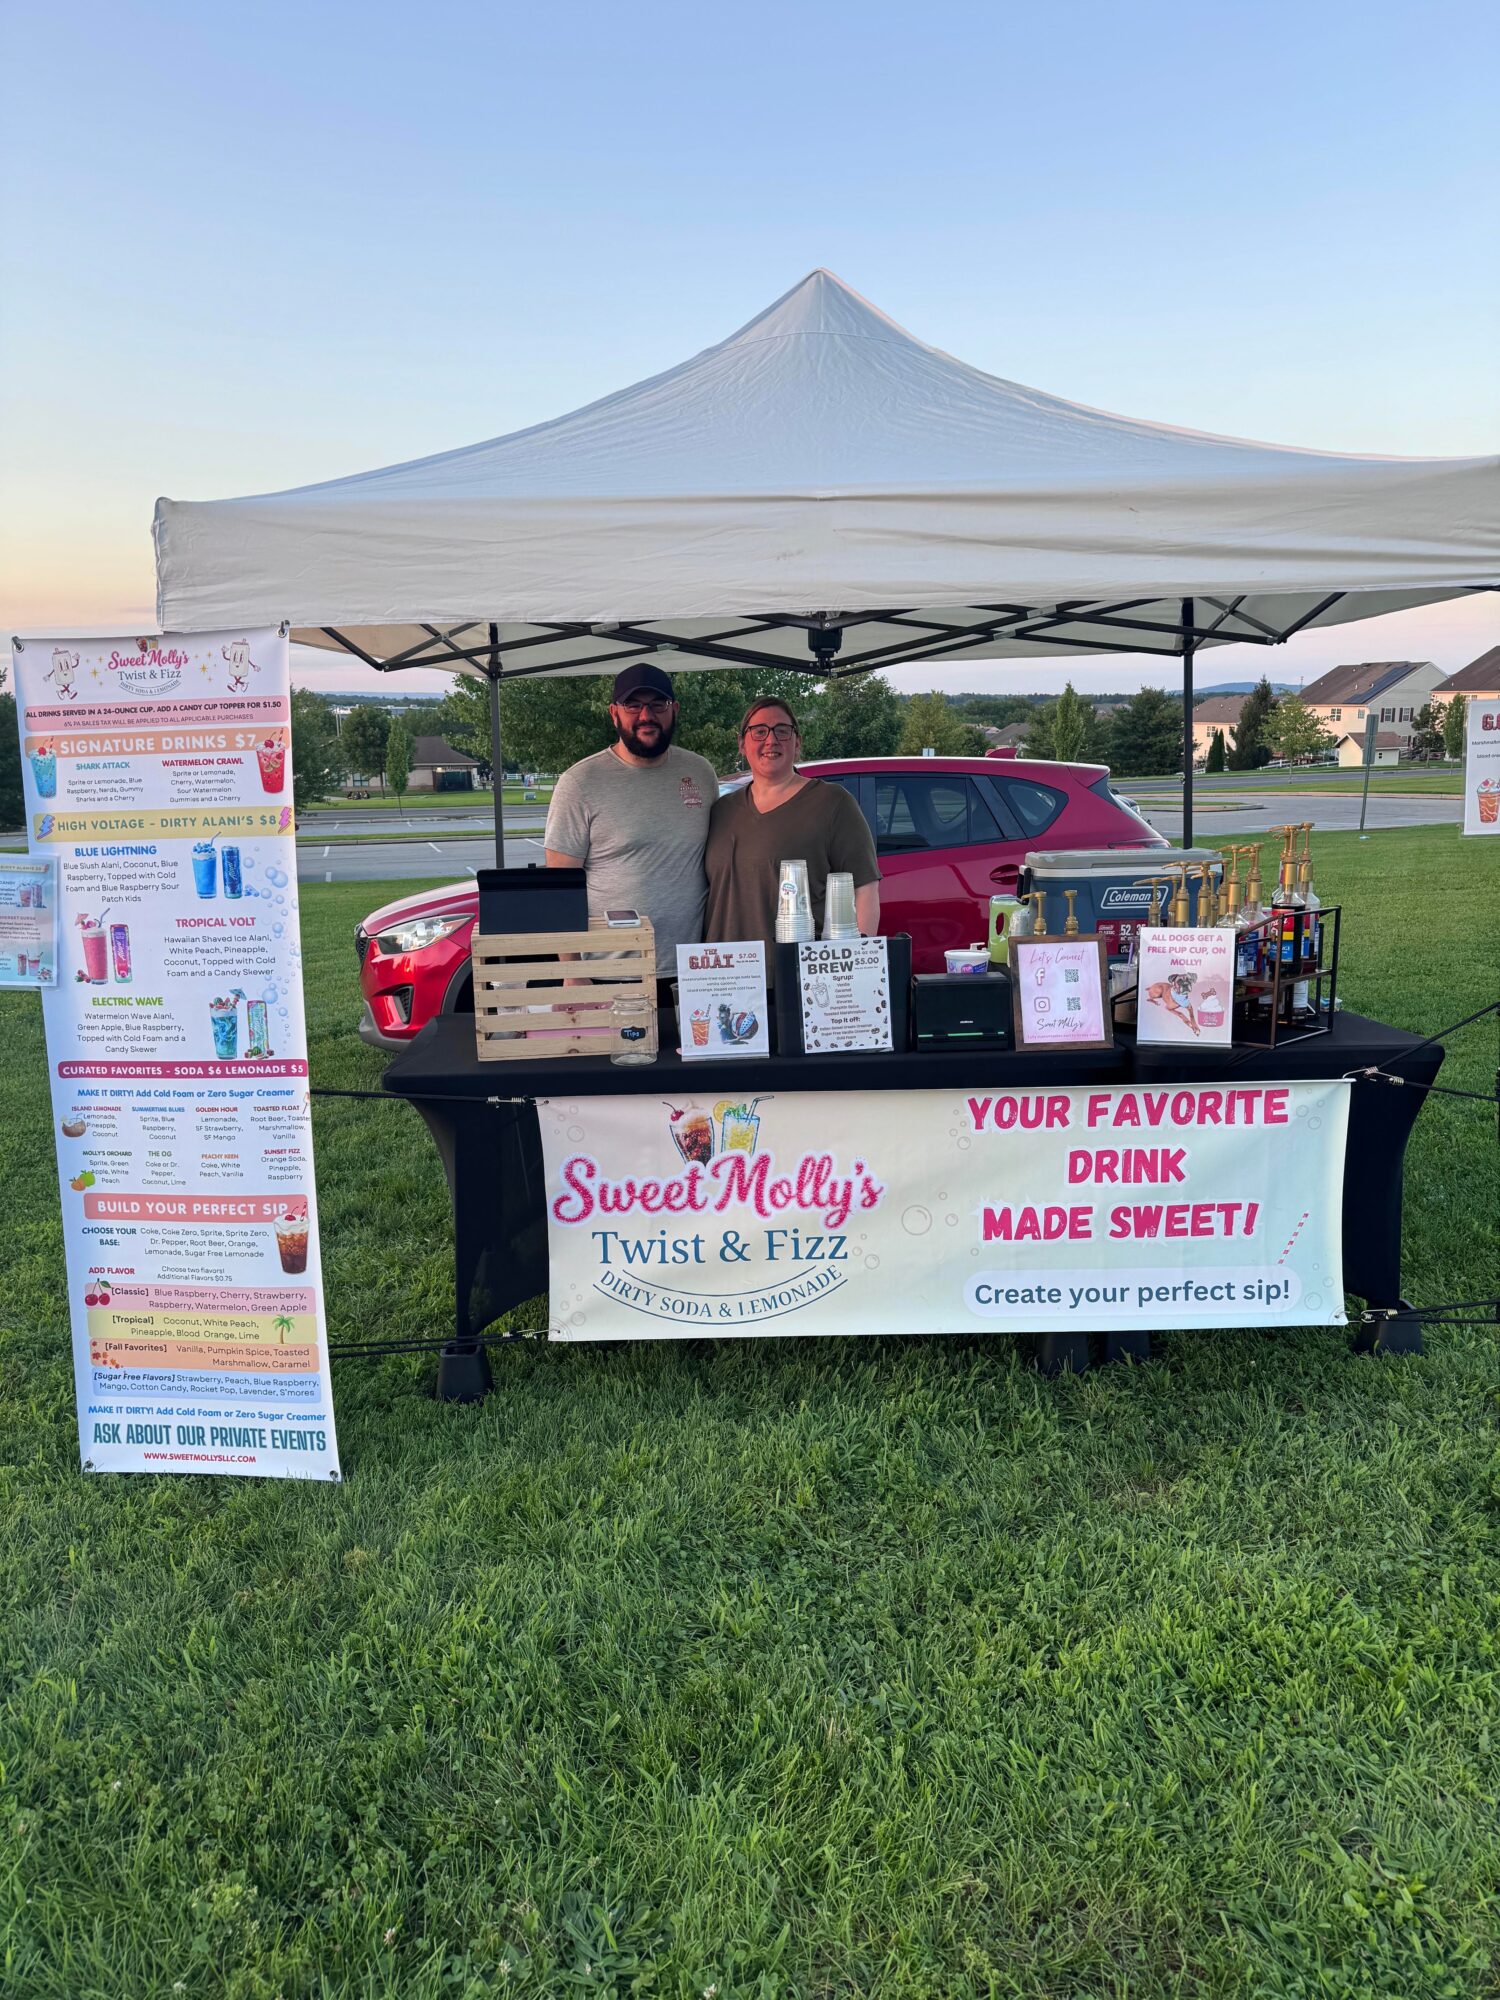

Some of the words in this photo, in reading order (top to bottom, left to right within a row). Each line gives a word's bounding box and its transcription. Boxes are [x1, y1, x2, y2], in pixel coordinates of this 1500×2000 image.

[108, 651, 149, 671] Sweet
[149, 650, 189, 670] Molly's
[117, 670, 147, 680] Twist
[149, 669, 158, 679] &
[160, 669, 182, 679] Fizz
[103, 706, 137, 714] 24-OUNCE
[262, 700, 281, 708] $1.50
[60, 737, 154, 754] SIGNATURE
[162, 734, 226, 750] DRINKS
[235, 733, 257, 748] $7
[76, 762, 100, 770] SHARK
[102, 761, 130, 769] ATTACK
[161, 758, 214, 767] WATERMELON
[216, 757, 243, 765] CRAWL
[57, 820, 86, 831] HIGH
[91, 818, 144, 830] VOLTAGE
[160, 817, 196, 827] DIRTY
[202, 815, 253, 826] ALANI'S
[259, 815, 276, 825] $8
[74, 847, 98, 856] BLUE
[101, 845, 156, 855] LIGHTNING
[1109, 890, 1152, 902] Coleman
[175, 917, 227, 927] TROPICAL
[229, 917, 256, 926] VOLT
[164, 935, 200, 943] Hawaiian
[1152, 934, 1167, 942] ALL
[1169, 934, 1195, 942] DOGS
[1197, 934, 1214, 942] GET
[807, 948, 852, 962] COLD
[1147, 946, 1167, 954] FREE
[1169, 946, 1187, 954] PUP
[1189, 946, 1209, 955] CUP,
[1212, 946, 1226, 954] ON
[854, 957, 879, 966] $5.00
[1170, 958, 1202, 966] MOLLY!
[807, 960, 854, 975] BREW
[832, 974, 854, 982] Syrup:
[92, 997, 133, 1006] ELECTRIC
[134, 996, 163, 1005] WAVE
[624, 1030, 640, 1038] Tips
[62, 1066, 107, 1074] CURATED
[111, 1066, 162, 1075] FAVORITES
[174, 1066, 203, 1075] SODA
[208, 1066, 221, 1075] $6
[225, 1065, 286, 1074] LEMONADE
[290, 1064, 303, 1073] $5
[968, 1095, 1071, 1130] YOUR
[1087, 1089, 1290, 1127] FAVORITE
[1068, 1148, 1187, 1184] DRINK
[553, 1157, 708, 1223] Sweet
[711, 1154, 883, 1229] Molly's
[97, 1201, 140, 1212] BUILD
[145, 1202, 186, 1214] YOUR
[193, 1203, 255, 1215] PERFECT
[262, 1203, 289, 1216] SIP
[982, 1205, 1093, 1241] MADE
[1109, 1202, 1259, 1238] SWEET!
[81, 1226, 114, 1234] CHOOSE
[592, 1230, 706, 1265] Twist
[719, 1230, 752, 1262] &
[764, 1228, 848, 1261] Fizz
[110, 1286, 148, 1296] [Classic]
[600, 1270, 657, 1306] DIRTY
[660, 1296, 712, 1318] SODA
[719, 1304, 732, 1318] &
[739, 1264, 842, 1316] LEMONADE
[974, 1284, 1062, 1305] Create
[1069, 1285, 1130, 1309] your
[1137, 1279, 1236, 1308] perfect
[1242, 1280, 1290, 1305] sip!
[112, 1315, 153, 1325] [Tropical]
[105, 1342, 122, 1352] [Fall
[124, 1343, 167, 1352] Favorites]
[93, 1372, 121, 1381] [Sugar
[123, 1372, 140, 1383] Free
[142, 1373, 176, 1384] Flavors]
[88, 1405, 113, 1414] MAKE
[125, 1406, 153, 1414] DIRTY!
[156, 1407, 173, 1415] Add
[175, 1408, 195, 1416] Cold
[197, 1408, 221, 1416] Foam
[235, 1410, 255, 1418] Zero
[257, 1411, 284, 1421] Sugar
[286, 1412, 326, 1421] Creamer
[93, 1422, 121, 1443] ASK
[126, 1423, 171, 1445] ABOUT
[177, 1425, 206, 1446] OUR
[210, 1426, 267, 1448] PRIVATE
[270, 1428, 326, 1451] EVENTS
[143, 1452, 256, 1463] WWW.SWEETMOLLYSLLC.COM
